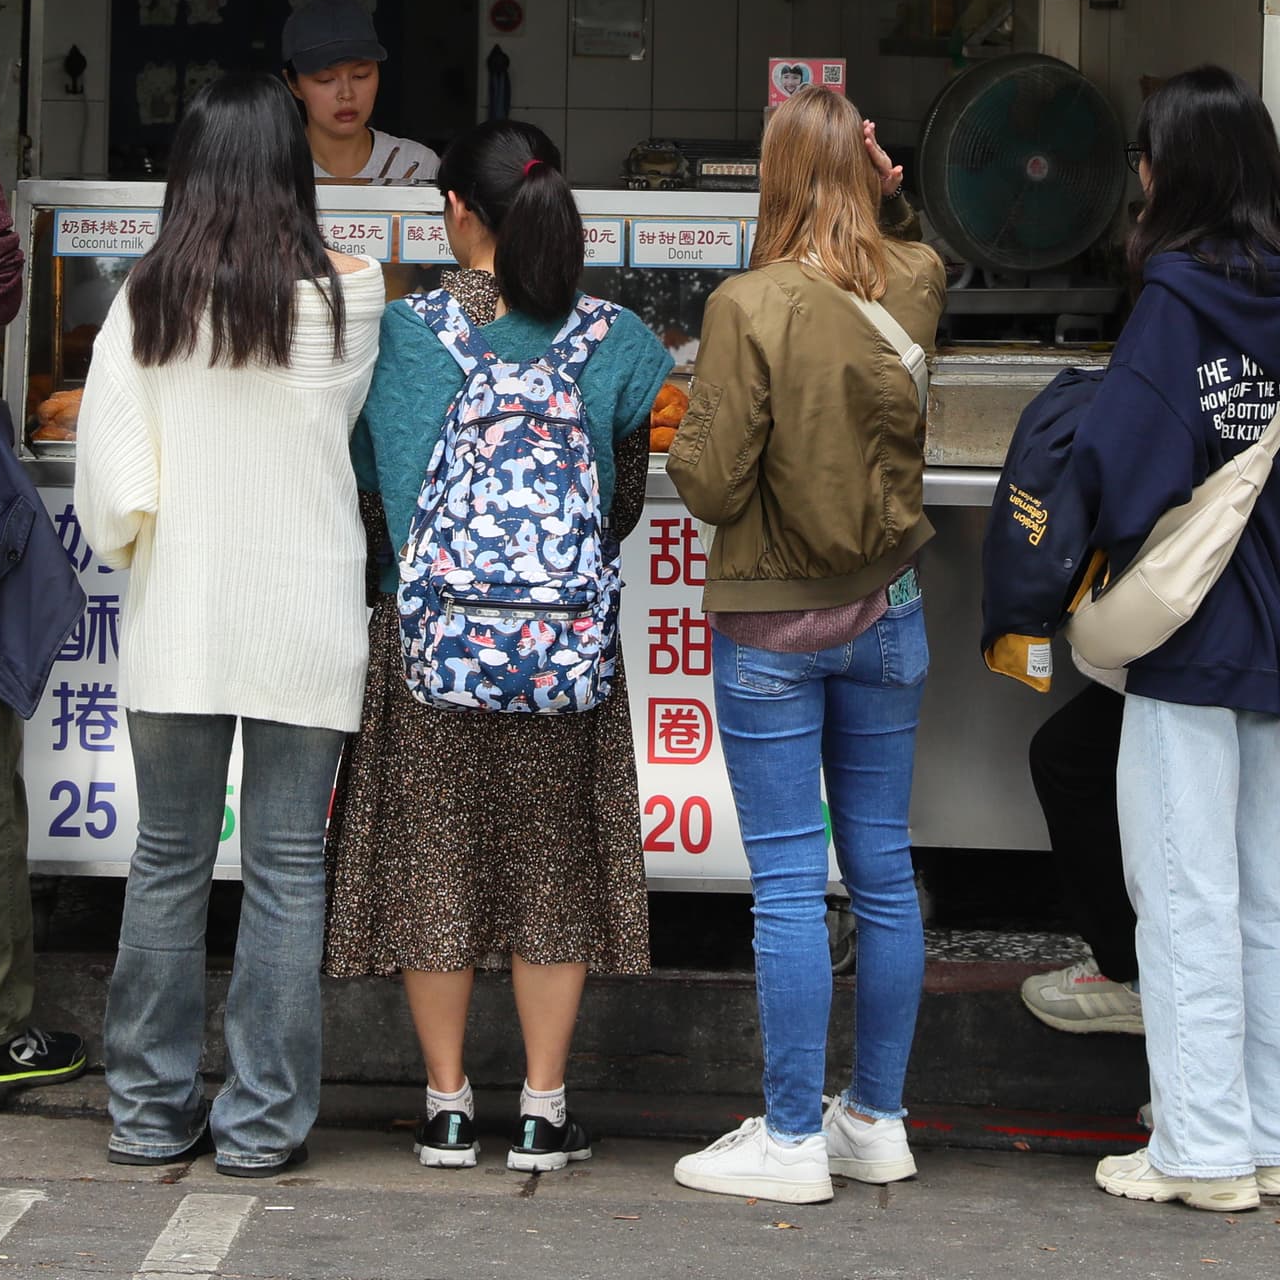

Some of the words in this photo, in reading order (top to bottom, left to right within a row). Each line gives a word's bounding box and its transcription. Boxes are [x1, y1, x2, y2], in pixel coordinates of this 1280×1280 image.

[61, 219, 156, 236] 奶酥捲25元
[638, 230, 734, 247] 甜甜圈20元
[71, 236, 118, 249] Coconut
[120, 236, 145, 249] milk
[668, 247, 704, 260] Donut
[1196, 358, 1231, 390] THE
[1256, 381, 1276, 399] THE
[1009, 495, 1049, 524] Craftsman
[1012, 510, 1048, 547] Precision
[647, 517, 713, 765] 甜甜圈
[48, 780, 118, 840] 25
[642, 794, 712, 854] 20
